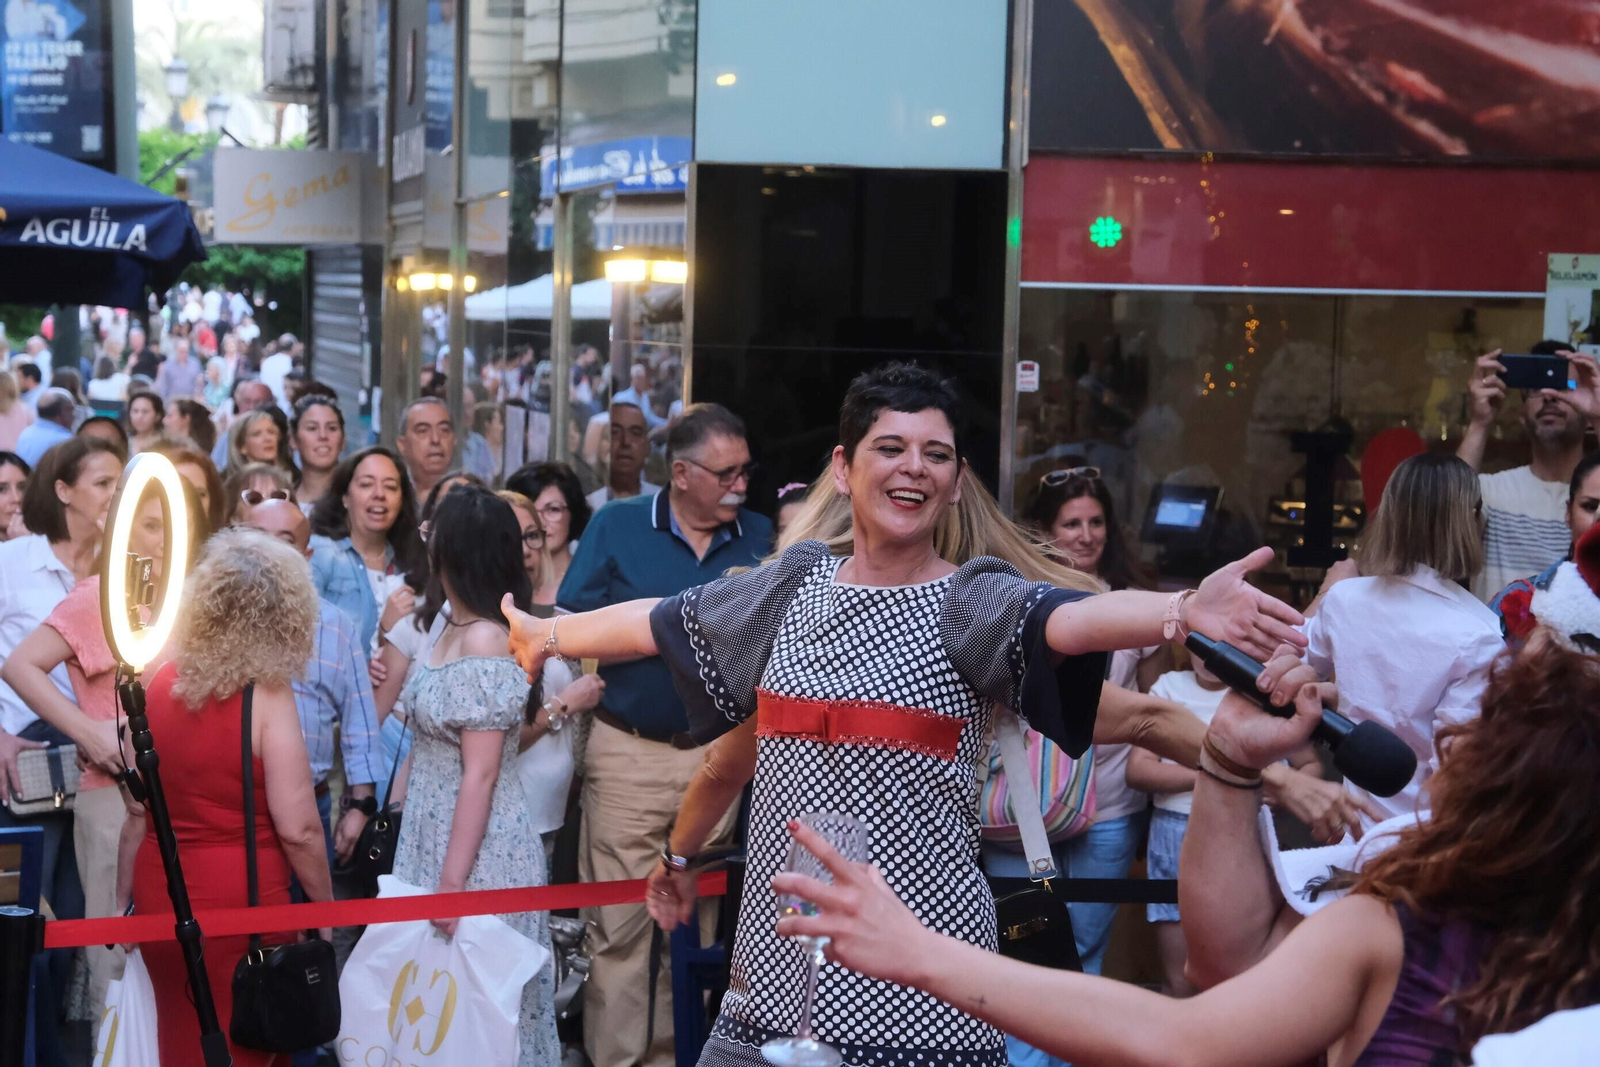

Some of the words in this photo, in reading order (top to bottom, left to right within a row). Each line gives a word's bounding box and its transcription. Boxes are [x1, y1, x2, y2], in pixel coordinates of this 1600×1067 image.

[90, 206, 110, 220] EL
[226, 166, 350, 232] Gema
[20, 217, 147, 252] AGUILA
